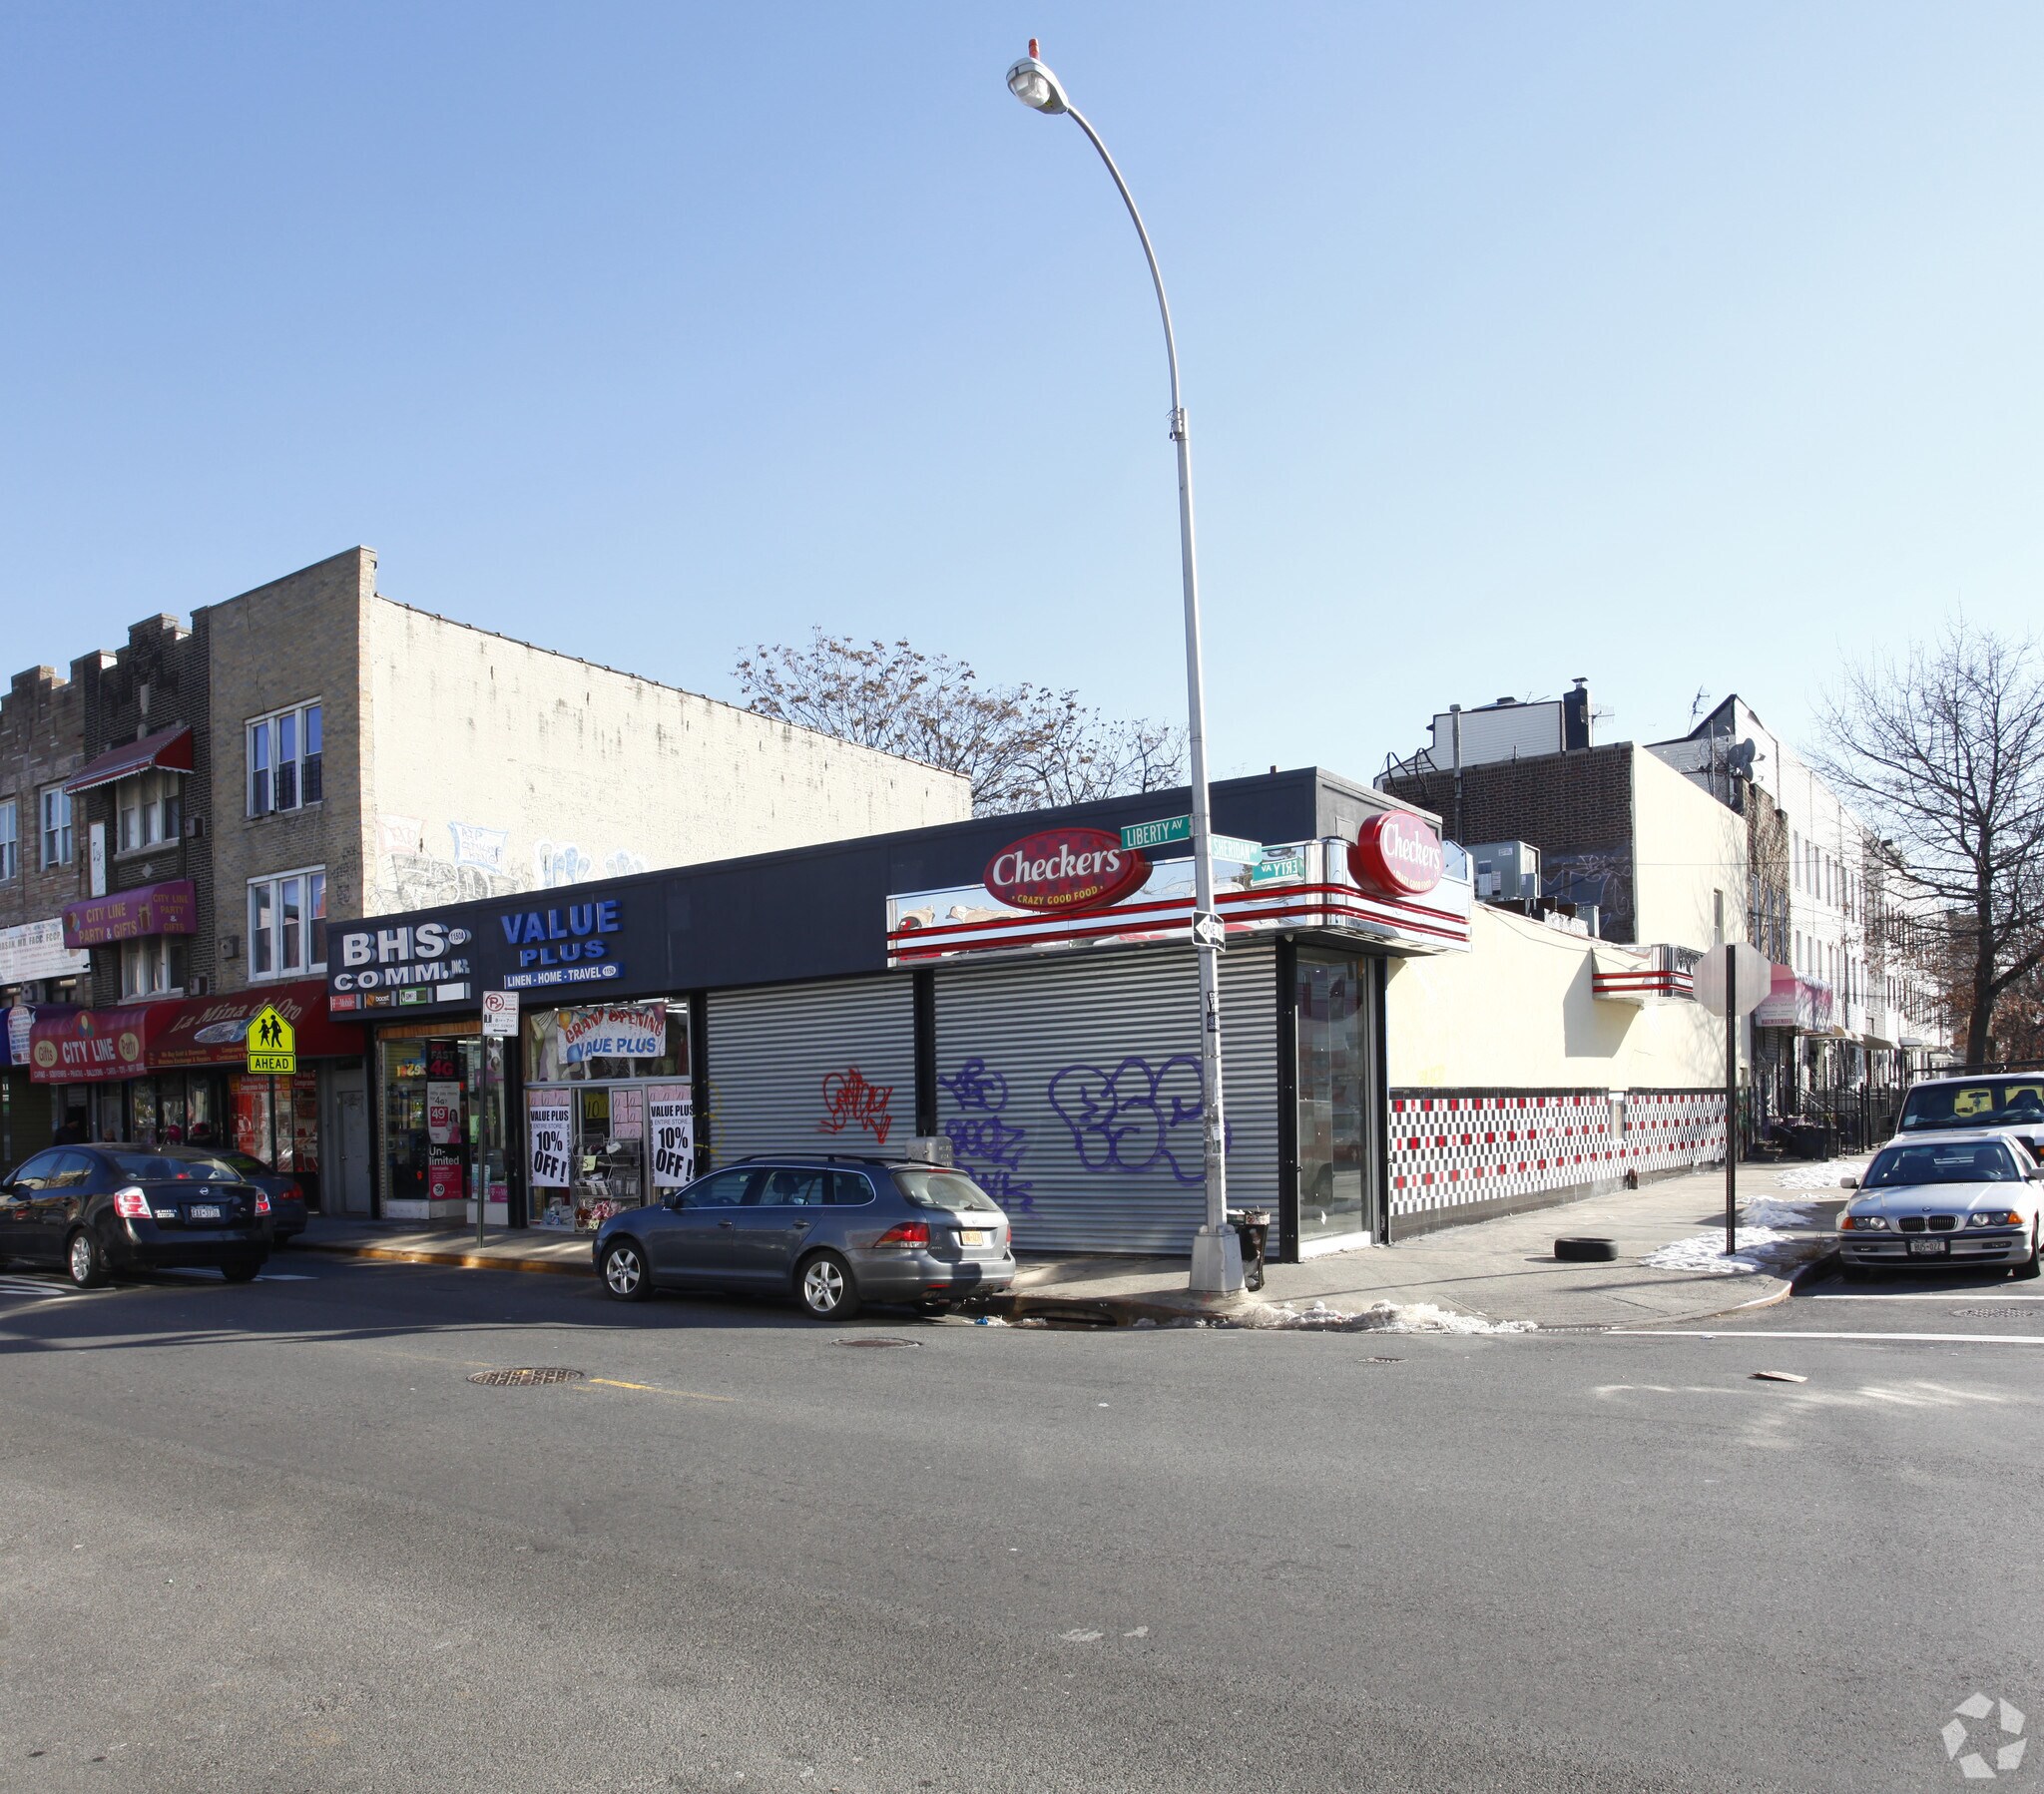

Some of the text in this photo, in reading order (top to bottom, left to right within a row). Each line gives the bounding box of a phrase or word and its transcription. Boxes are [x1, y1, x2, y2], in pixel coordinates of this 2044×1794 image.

[1126, 818, 1184, 848] LIBERTY AV
[1213, 837, 1251, 862] SHERIDAN
[1383, 822, 1440, 871] Checkers
[992, 843, 1121, 886] Checkers
[153, 893, 190, 904] CITY LINE
[1017, 885, 1098, 905] CRAZY GOOD FOOD
[86, 902, 127, 924] CITY LINE
[160, 905, 185, 915] PARTY
[170, 914, 178, 923] &
[79, 921, 138, 944] PARTY & GIFTS
[163, 923, 186, 933] GIFTS
[500, 899, 620, 945] VALUE
[342, 922, 447, 967] BHS
[519, 939, 607, 968] PLUS
[333, 961, 450, 991] COMM.
[507, 974, 532, 988] LINEN
[538, 971, 562, 985] HOME
[568, 966, 602, 981] TRAVEL
[169, 997, 303, 1034] La Mina d Oro
[608, 1008, 666, 1038] OPENING
[38, 1046, 54, 1063] Gifts
[62, 1038, 117, 1065] CITY LINE
[121, 1039, 138, 1059] Party
[616, 1037, 657, 1054] PLUS
[255, 1058, 289, 1070] AHEAD
[429, 1059, 455, 1077] 4G
[530, 1110, 569, 1121] VALUE PLUS
[651, 1104, 695, 1118] VALUE PLUS
[536, 1130, 563, 1152] 10%
[658, 1125, 689, 1149] 10%
[428, 1145, 446, 1156] Un-
[429, 1155, 460, 1165] limited
